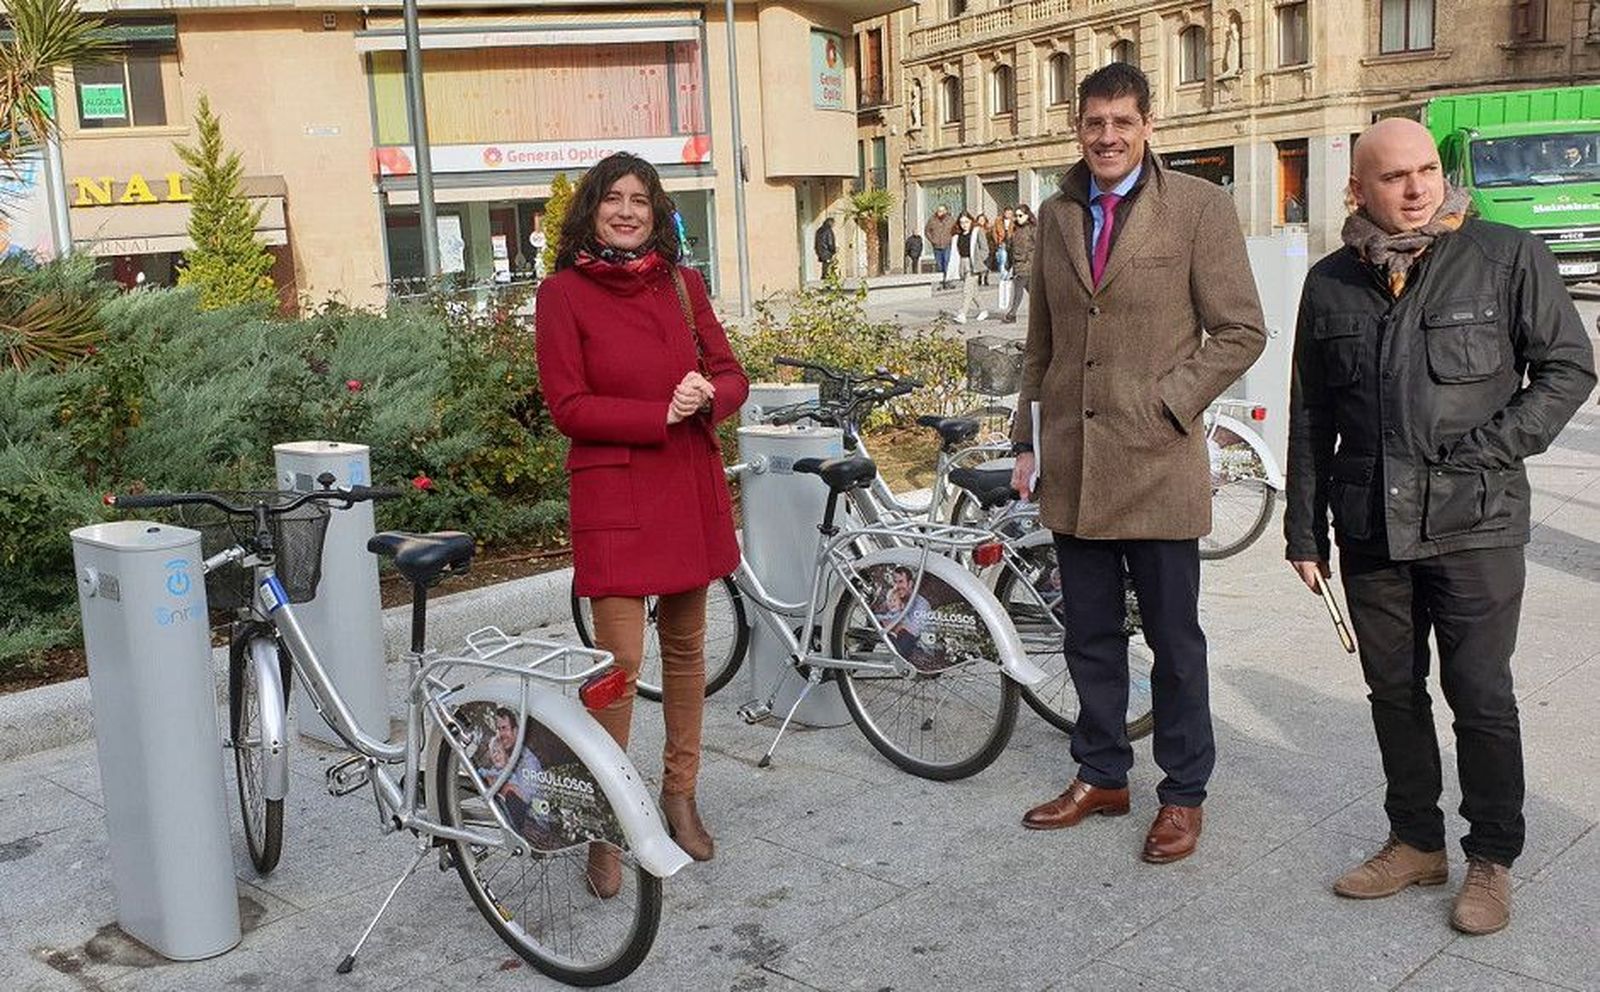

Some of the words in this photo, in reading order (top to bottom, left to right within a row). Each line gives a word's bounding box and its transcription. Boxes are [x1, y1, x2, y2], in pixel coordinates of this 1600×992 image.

[507, 147, 564, 163] General
[913, 608, 977, 626] ORGULLOSOS
[521, 767, 595, 795] ORGULLOSOS
